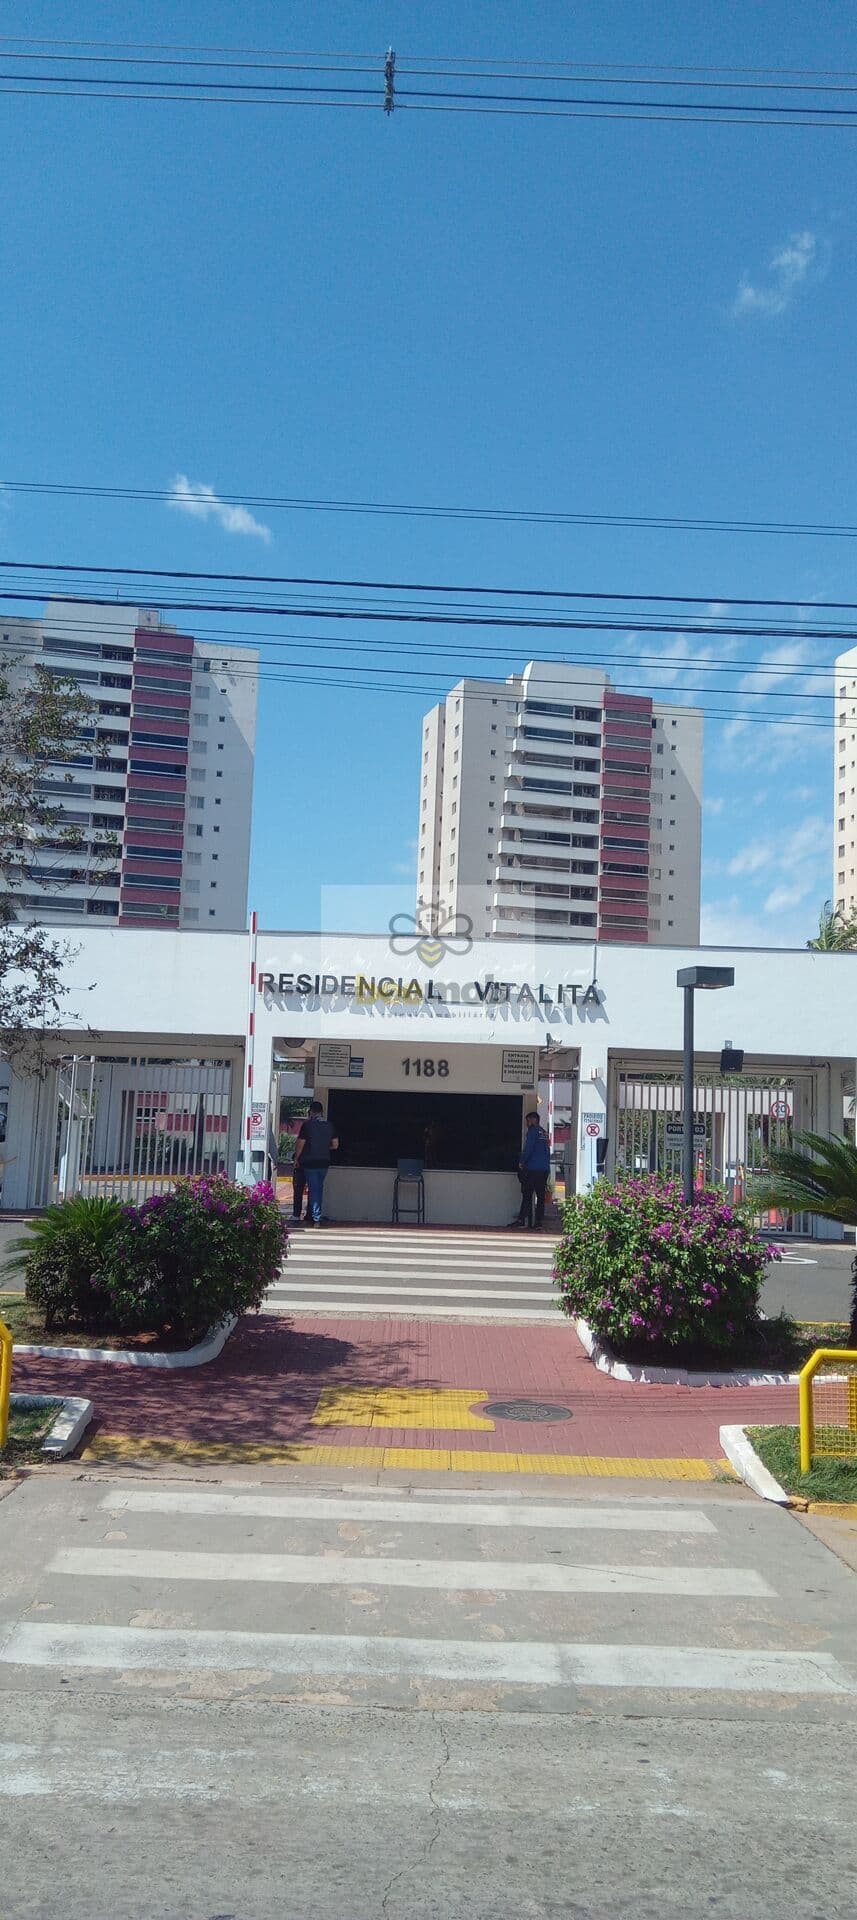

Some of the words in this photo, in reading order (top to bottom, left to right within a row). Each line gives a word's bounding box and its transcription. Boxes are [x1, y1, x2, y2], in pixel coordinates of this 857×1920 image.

[258, 972, 443, 1000] RESIDENCIAL
[401, 1058, 450, 1077] 1188
[775, 1104, 786, 1113] 20
